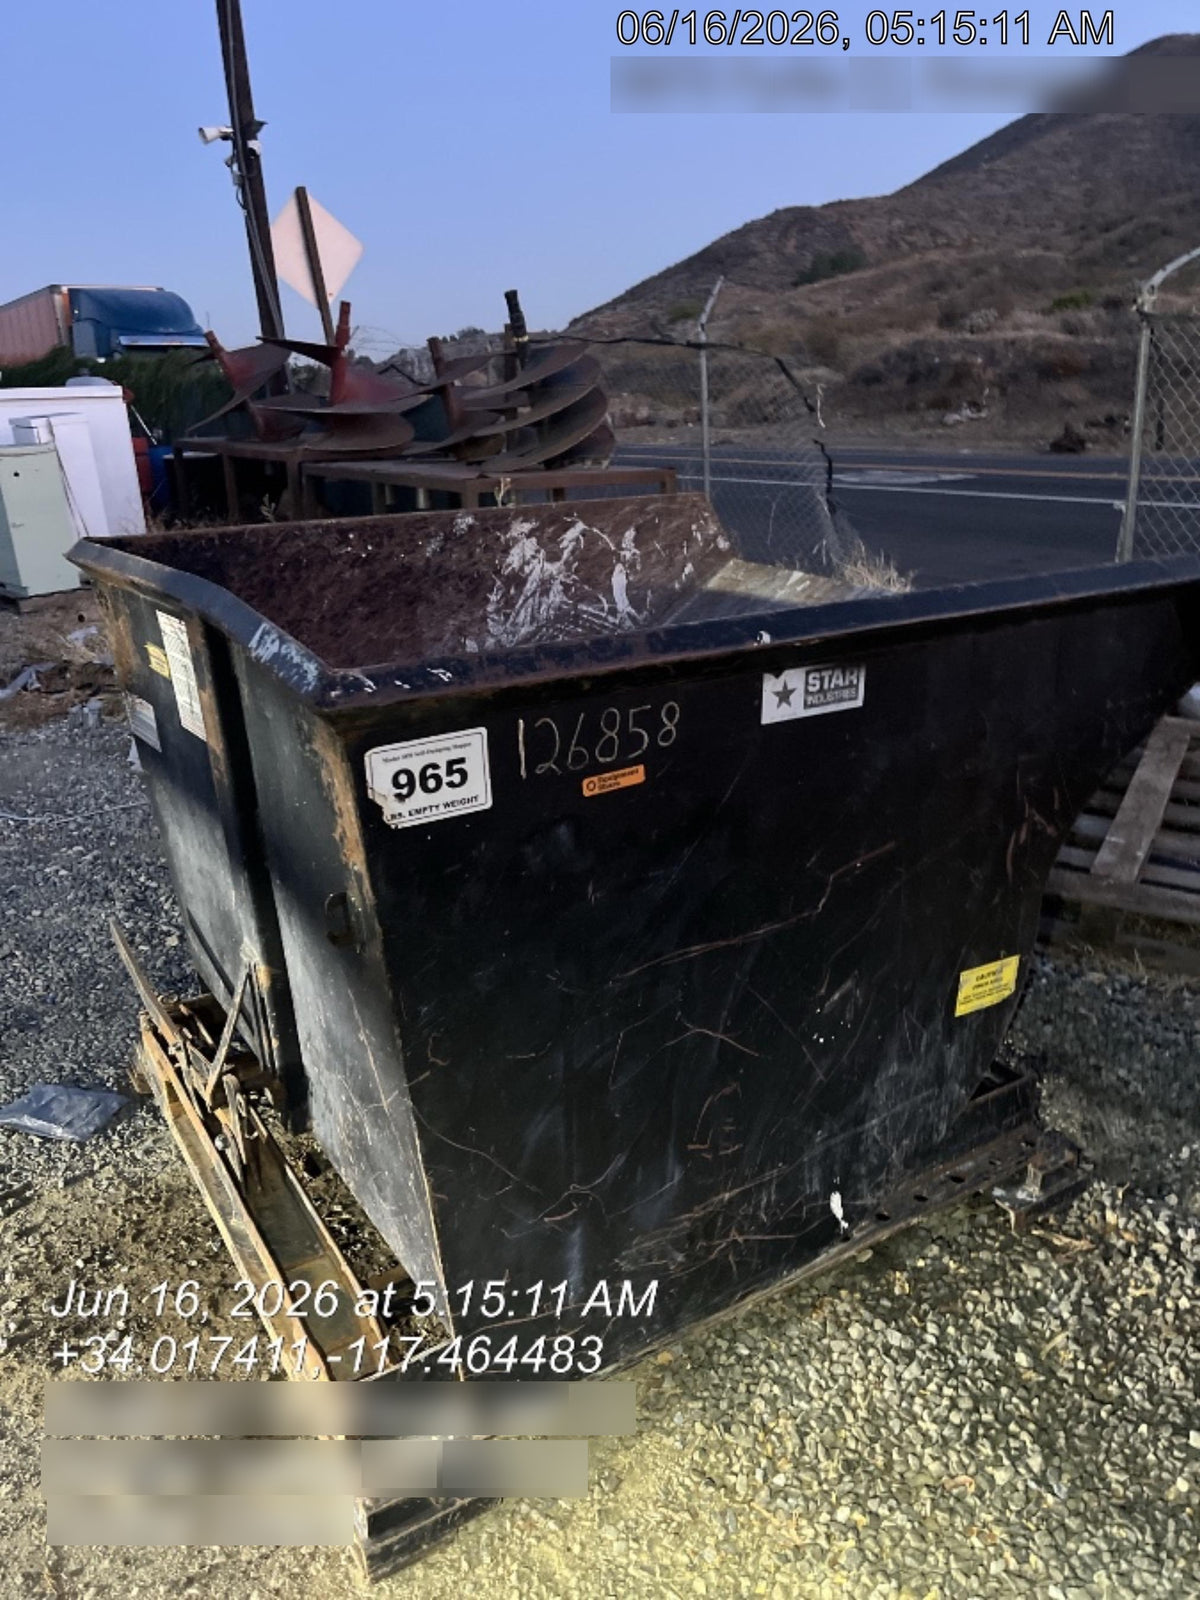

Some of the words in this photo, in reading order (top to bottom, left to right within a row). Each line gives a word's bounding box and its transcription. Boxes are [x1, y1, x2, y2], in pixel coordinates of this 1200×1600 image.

[807, 667, 859, 693] STAR
[517, 701, 680, 780] 126858
[391, 757, 468, 802] 965
[408, 804, 440, 816] EMPTY
[442, 795, 479, 809] WEIGHT
